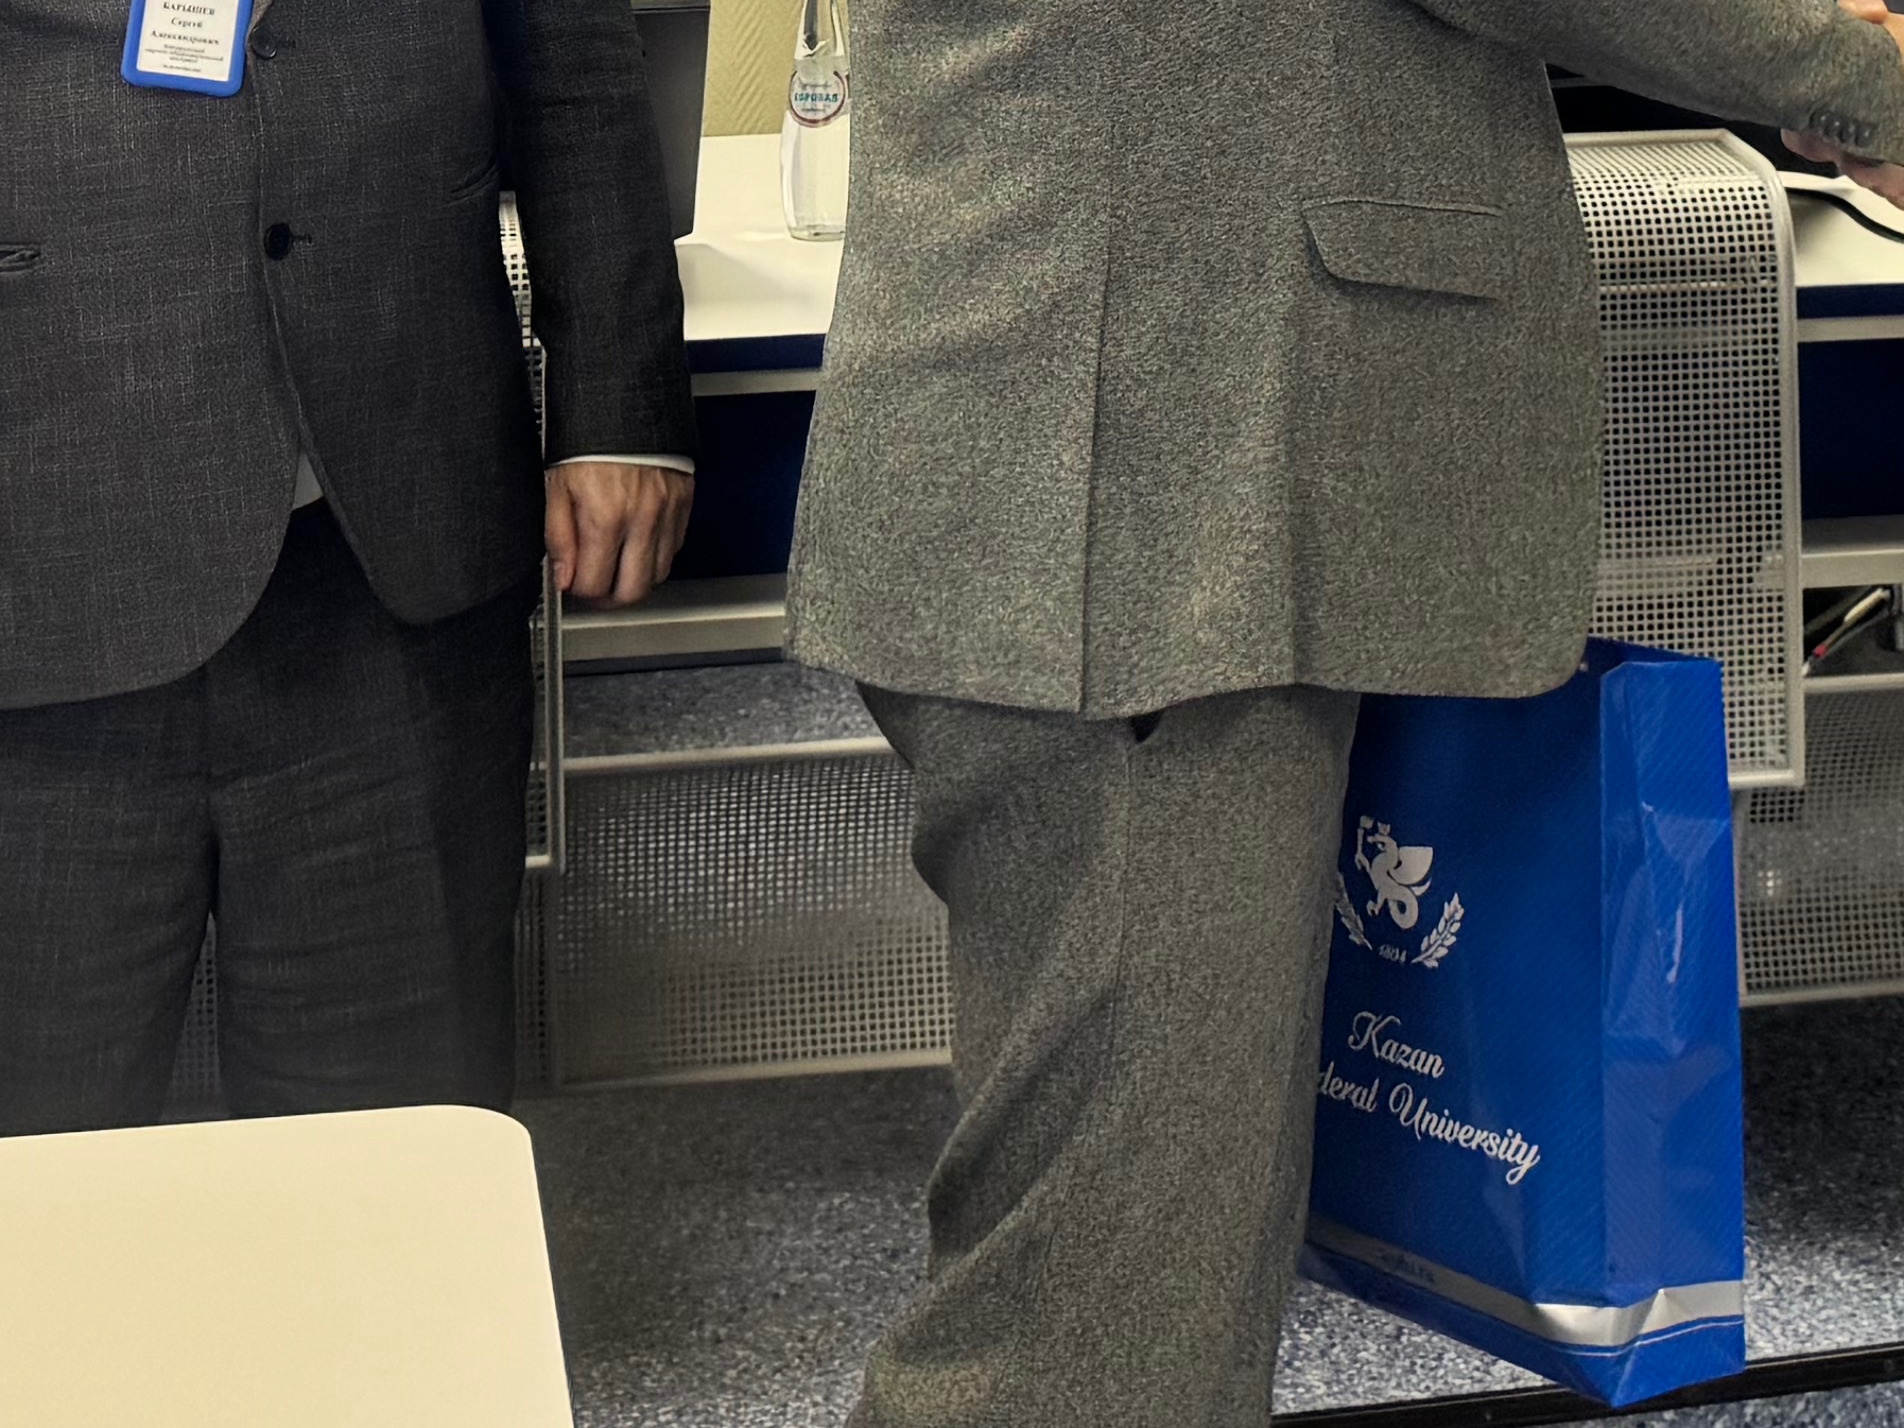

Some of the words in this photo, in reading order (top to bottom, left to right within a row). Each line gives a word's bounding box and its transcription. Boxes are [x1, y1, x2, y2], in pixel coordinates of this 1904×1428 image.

[1348, 1011, 1445, 1078] Kazan
[1318, 1060, 1380, 1113] deral
[1389, 1082, 1541, 1185] University
